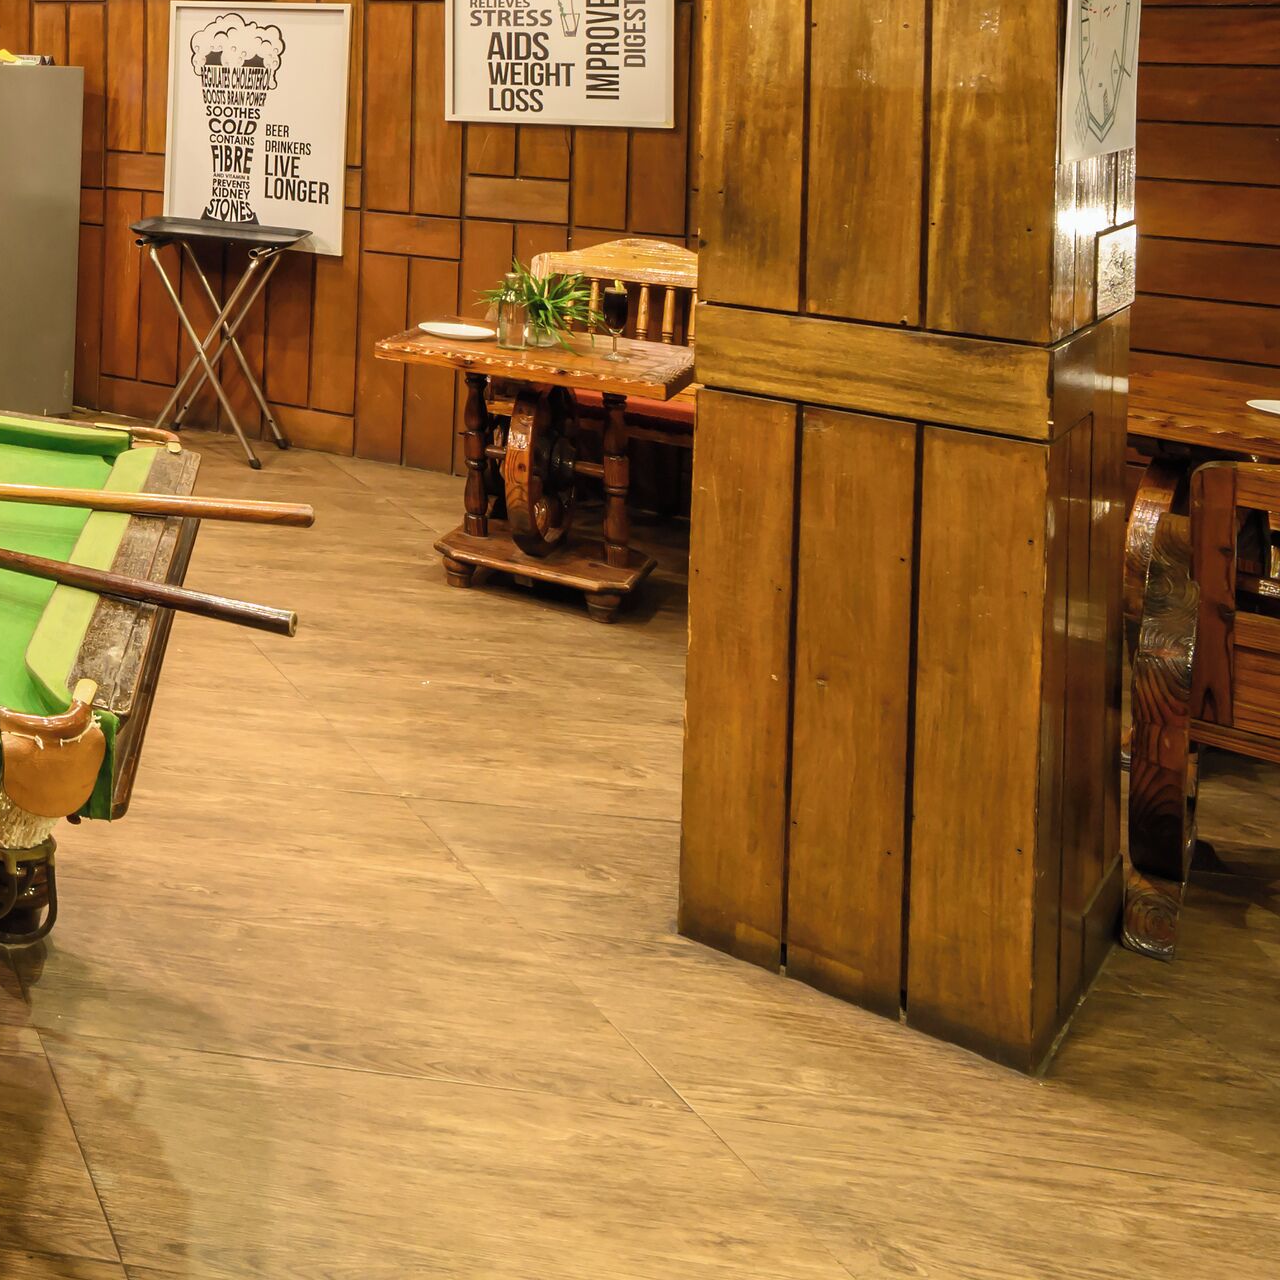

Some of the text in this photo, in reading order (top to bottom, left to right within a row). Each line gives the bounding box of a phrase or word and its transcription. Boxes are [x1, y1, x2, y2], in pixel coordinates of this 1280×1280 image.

[470, 9, 552, 27] STRESS
[488, 31, 550, 60] AIDS
[201, 67, 272, 90] REGULATES CHOLESTEROL
[488, 62, 575, 87] WEIGHT
[203, 90, 266, 106] BOOSTS BRAIN POWER
[489, 88, 543, 112] LOSS
[206, 106, 260, 119] SOOTHES
[209, 118, 257, 135] COLD
[266, 124, 289, 137] BEER
[210, 134, 255, 145] CONTAINS
[265, 140, 311, 155] DRINKERS
[211, 145, 253, 174] FIBRE
[265, 155, 300, 178] LIVE
[213, 179, 250, 190] PREVENTS
[265, 178, 329, 204] LONGER
[212, 187, 250, 200] KIDNEY
